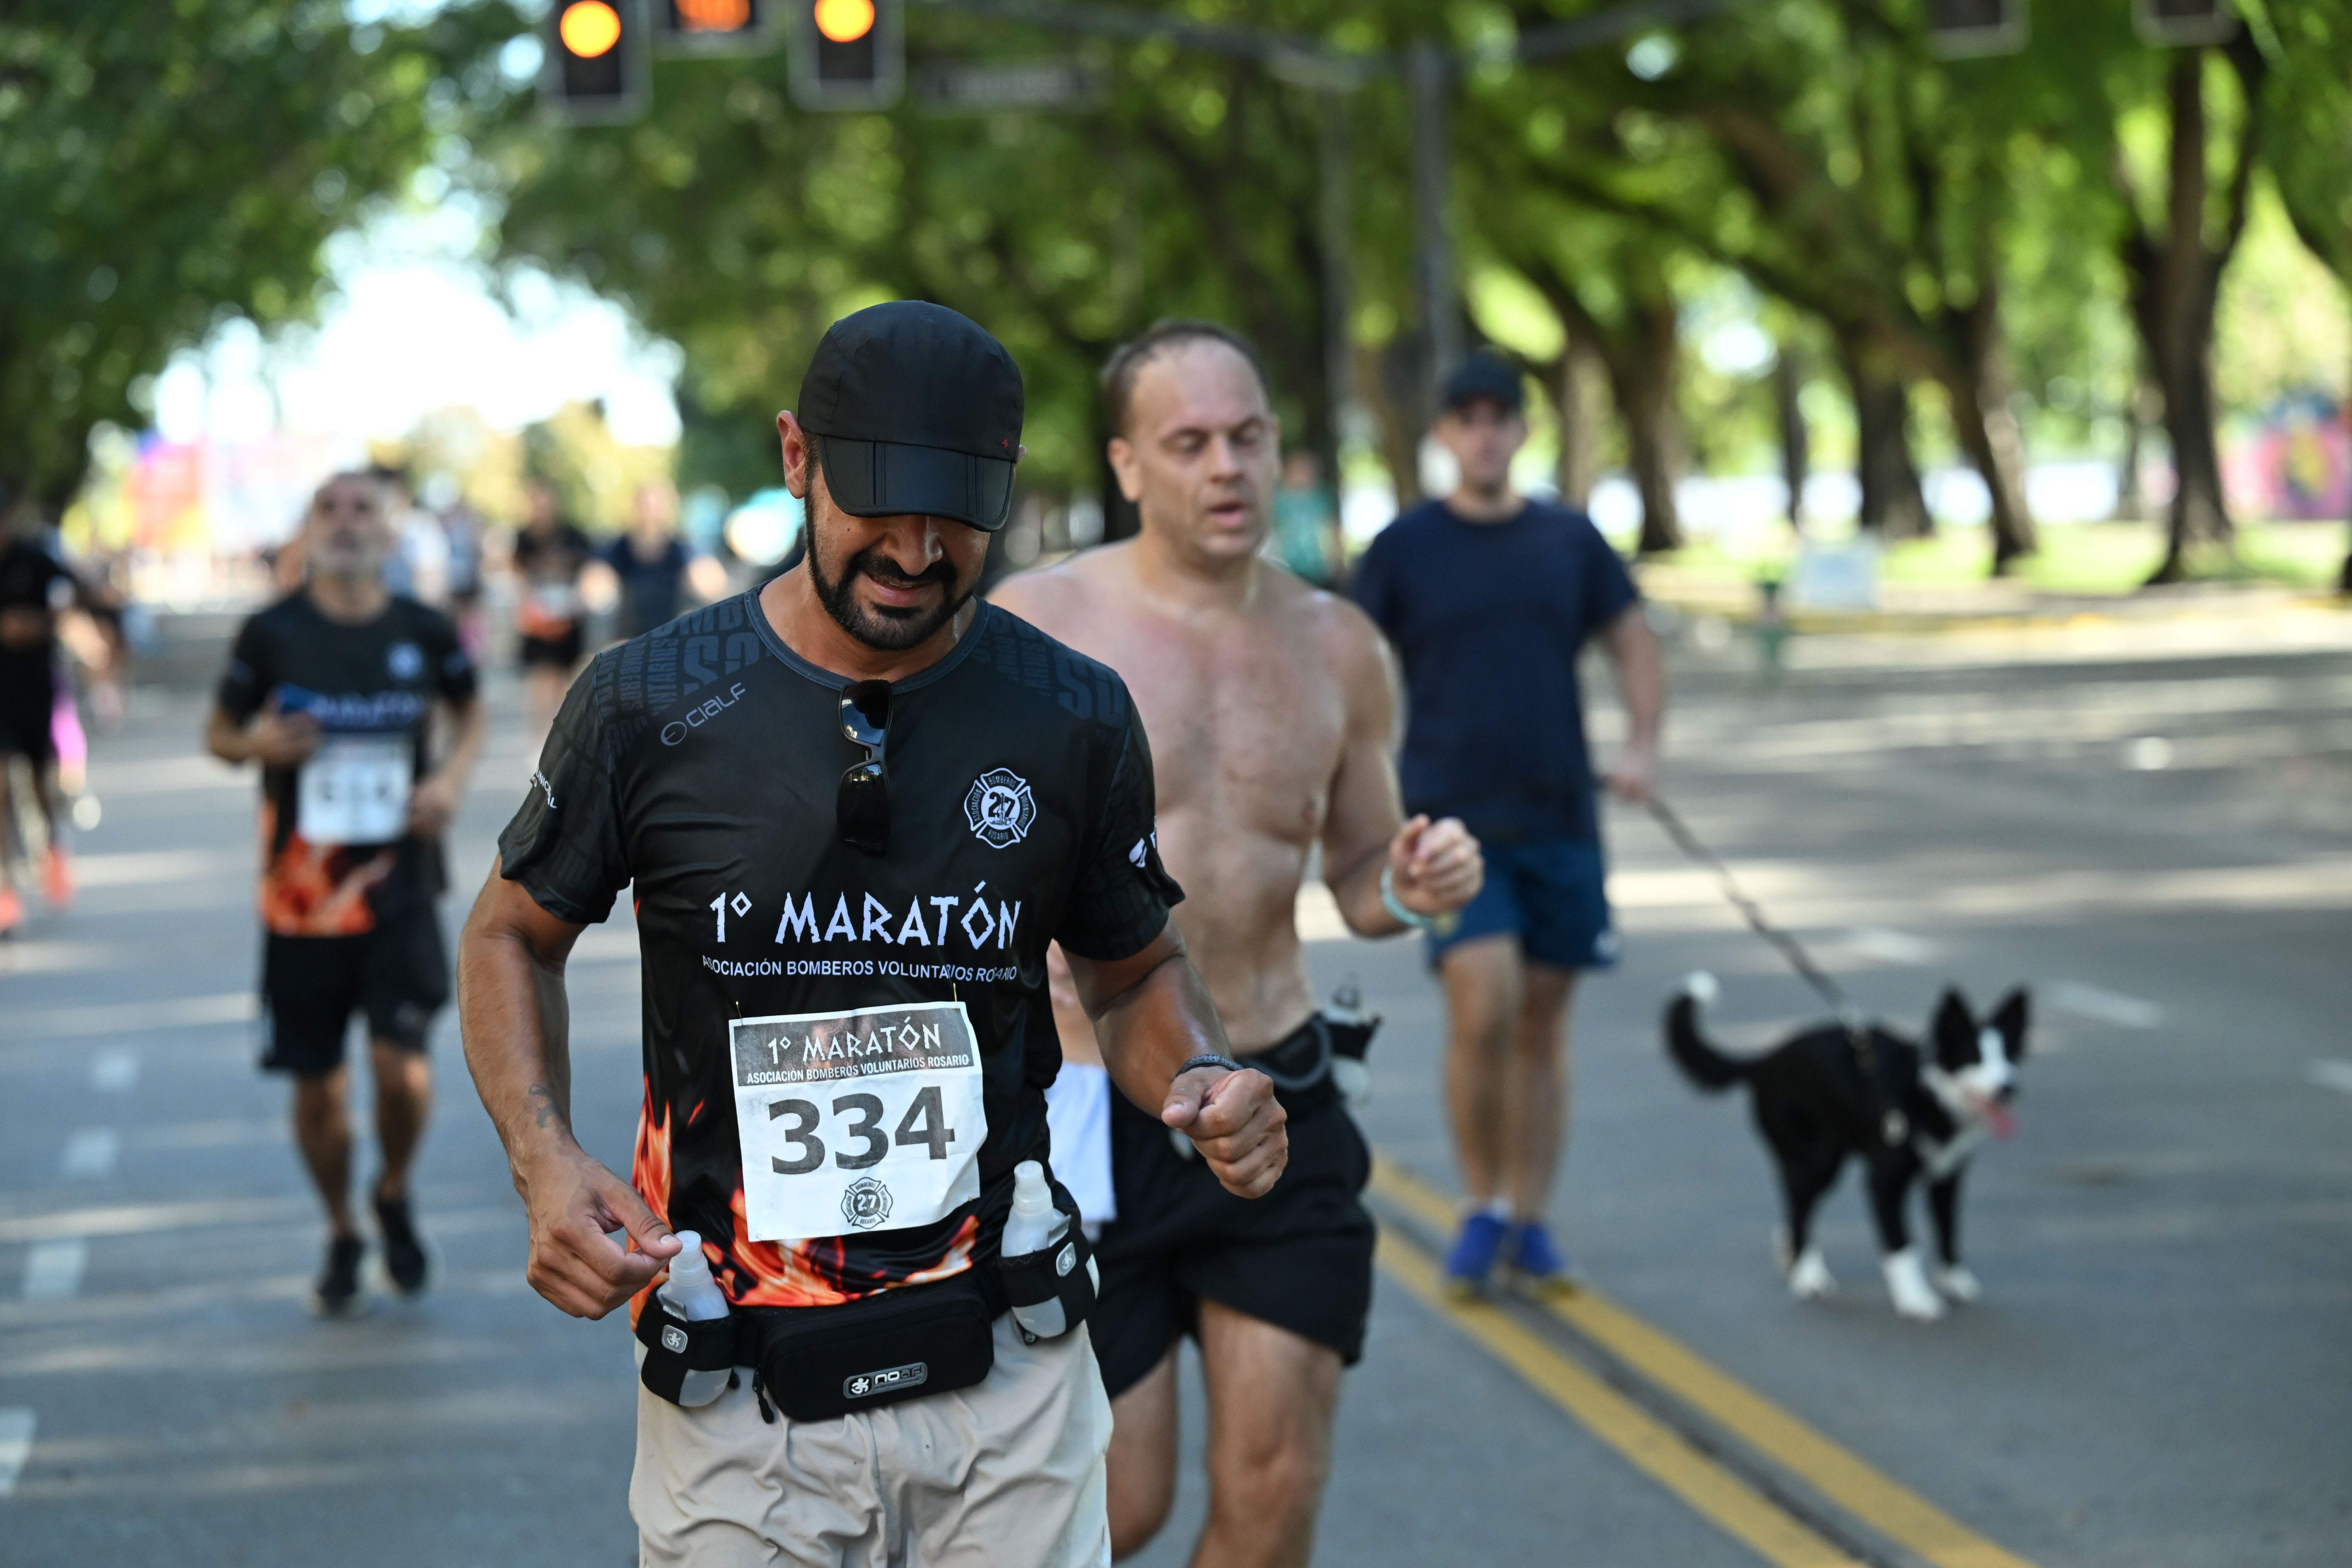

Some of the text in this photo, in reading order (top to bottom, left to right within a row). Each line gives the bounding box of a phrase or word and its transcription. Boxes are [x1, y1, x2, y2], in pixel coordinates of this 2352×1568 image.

[988, 775, 1016, 788] BOMBEROS
[988, 792, 1015, 817] 27
[987, 829, 1008, 840] ROSARIO
[775, 880, 1021, 950] MARATÓN
[702, 955, 1017, 982] ASOCIACIÓN BOMBEROS VOLUNTARIOS ROARIO
[803, 1016, 941, 1062] MARATÓN
[747, 1054, 969, 1084] ASOCIACIÓN BOMBEROS VOLUNTARIOS ROSARIO
[768, 1086, 956, 1175] 334
[857, 1194, 877, 1211] 27
